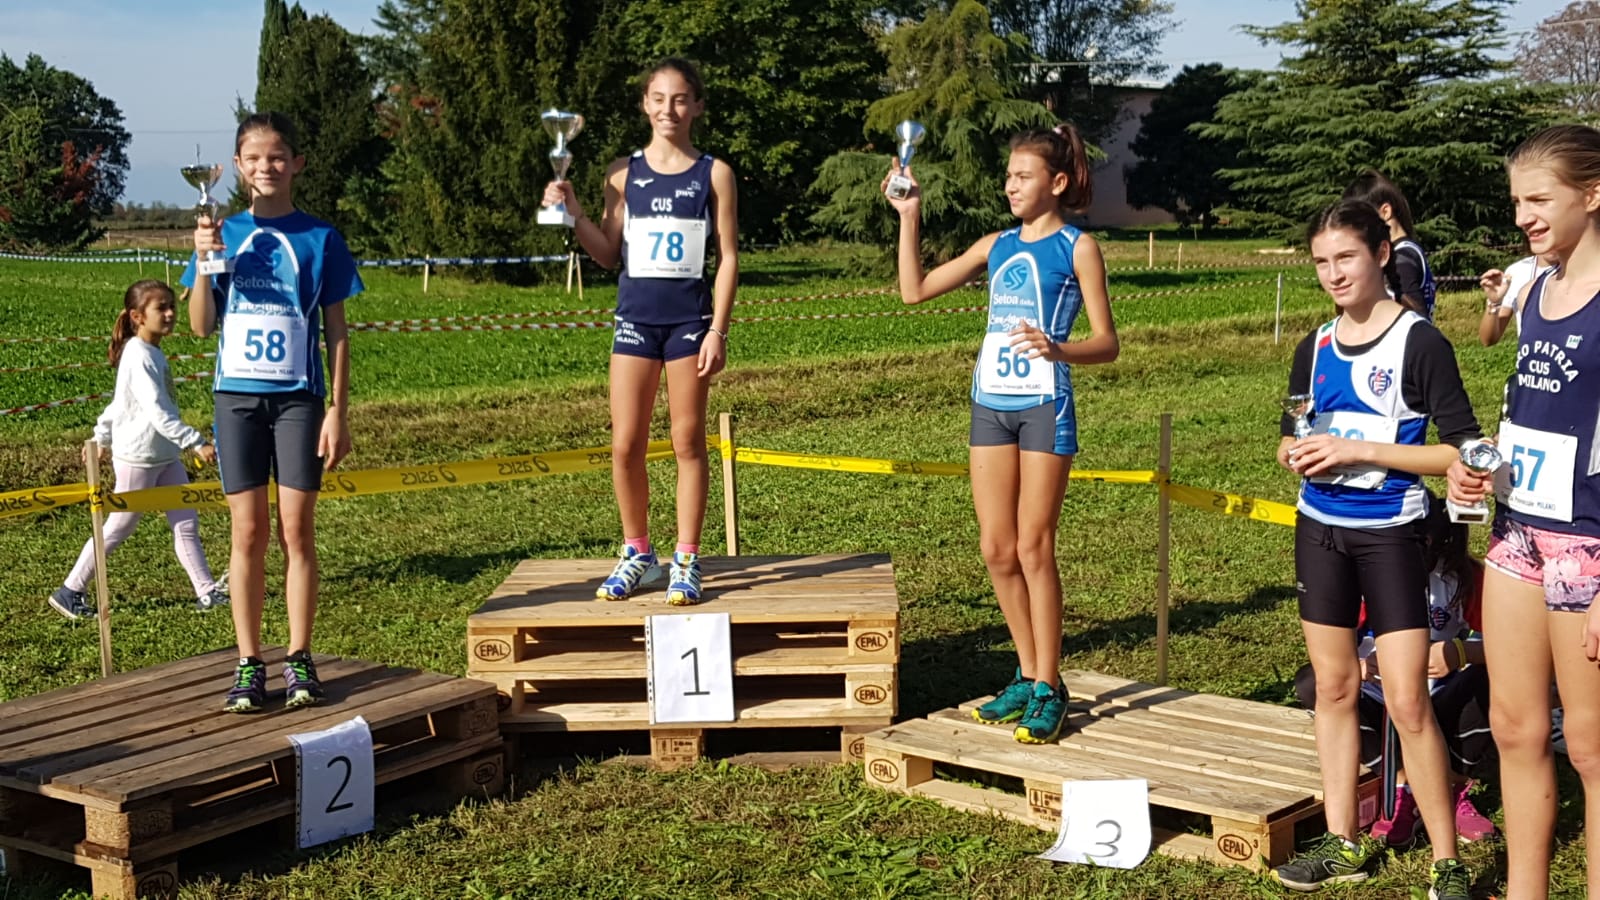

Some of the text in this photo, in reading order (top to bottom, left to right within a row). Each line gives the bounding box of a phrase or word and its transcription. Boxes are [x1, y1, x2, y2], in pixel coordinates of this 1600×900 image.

[651, 198, 673, 212] CUS
[648, 231, 684, 262] 78
[993, 293, 1018, 305] Setoa
[244, 328, 286, 363] 58
[997, 346, 1031, 378] 56
[1529, 360, 1550, 375] CUS
[1534, 341, 1579, 382] PATRIA
[1518, 374, 1561, 393] MILANO
[1510, 444, 1546, 491] 57
[480, 645, 505, 657] EPAL
[860, 637, 883, 648] EPAL
[681, 647, 710, 696] 1
[859, 689, 882, 700] EPAL
[874, 763, 895, 779] EPAL
[325, 755, 354, 813] 2
[1082, 820, 1122, 857] 3
[1223, 838, 1248, 857] EPAL
